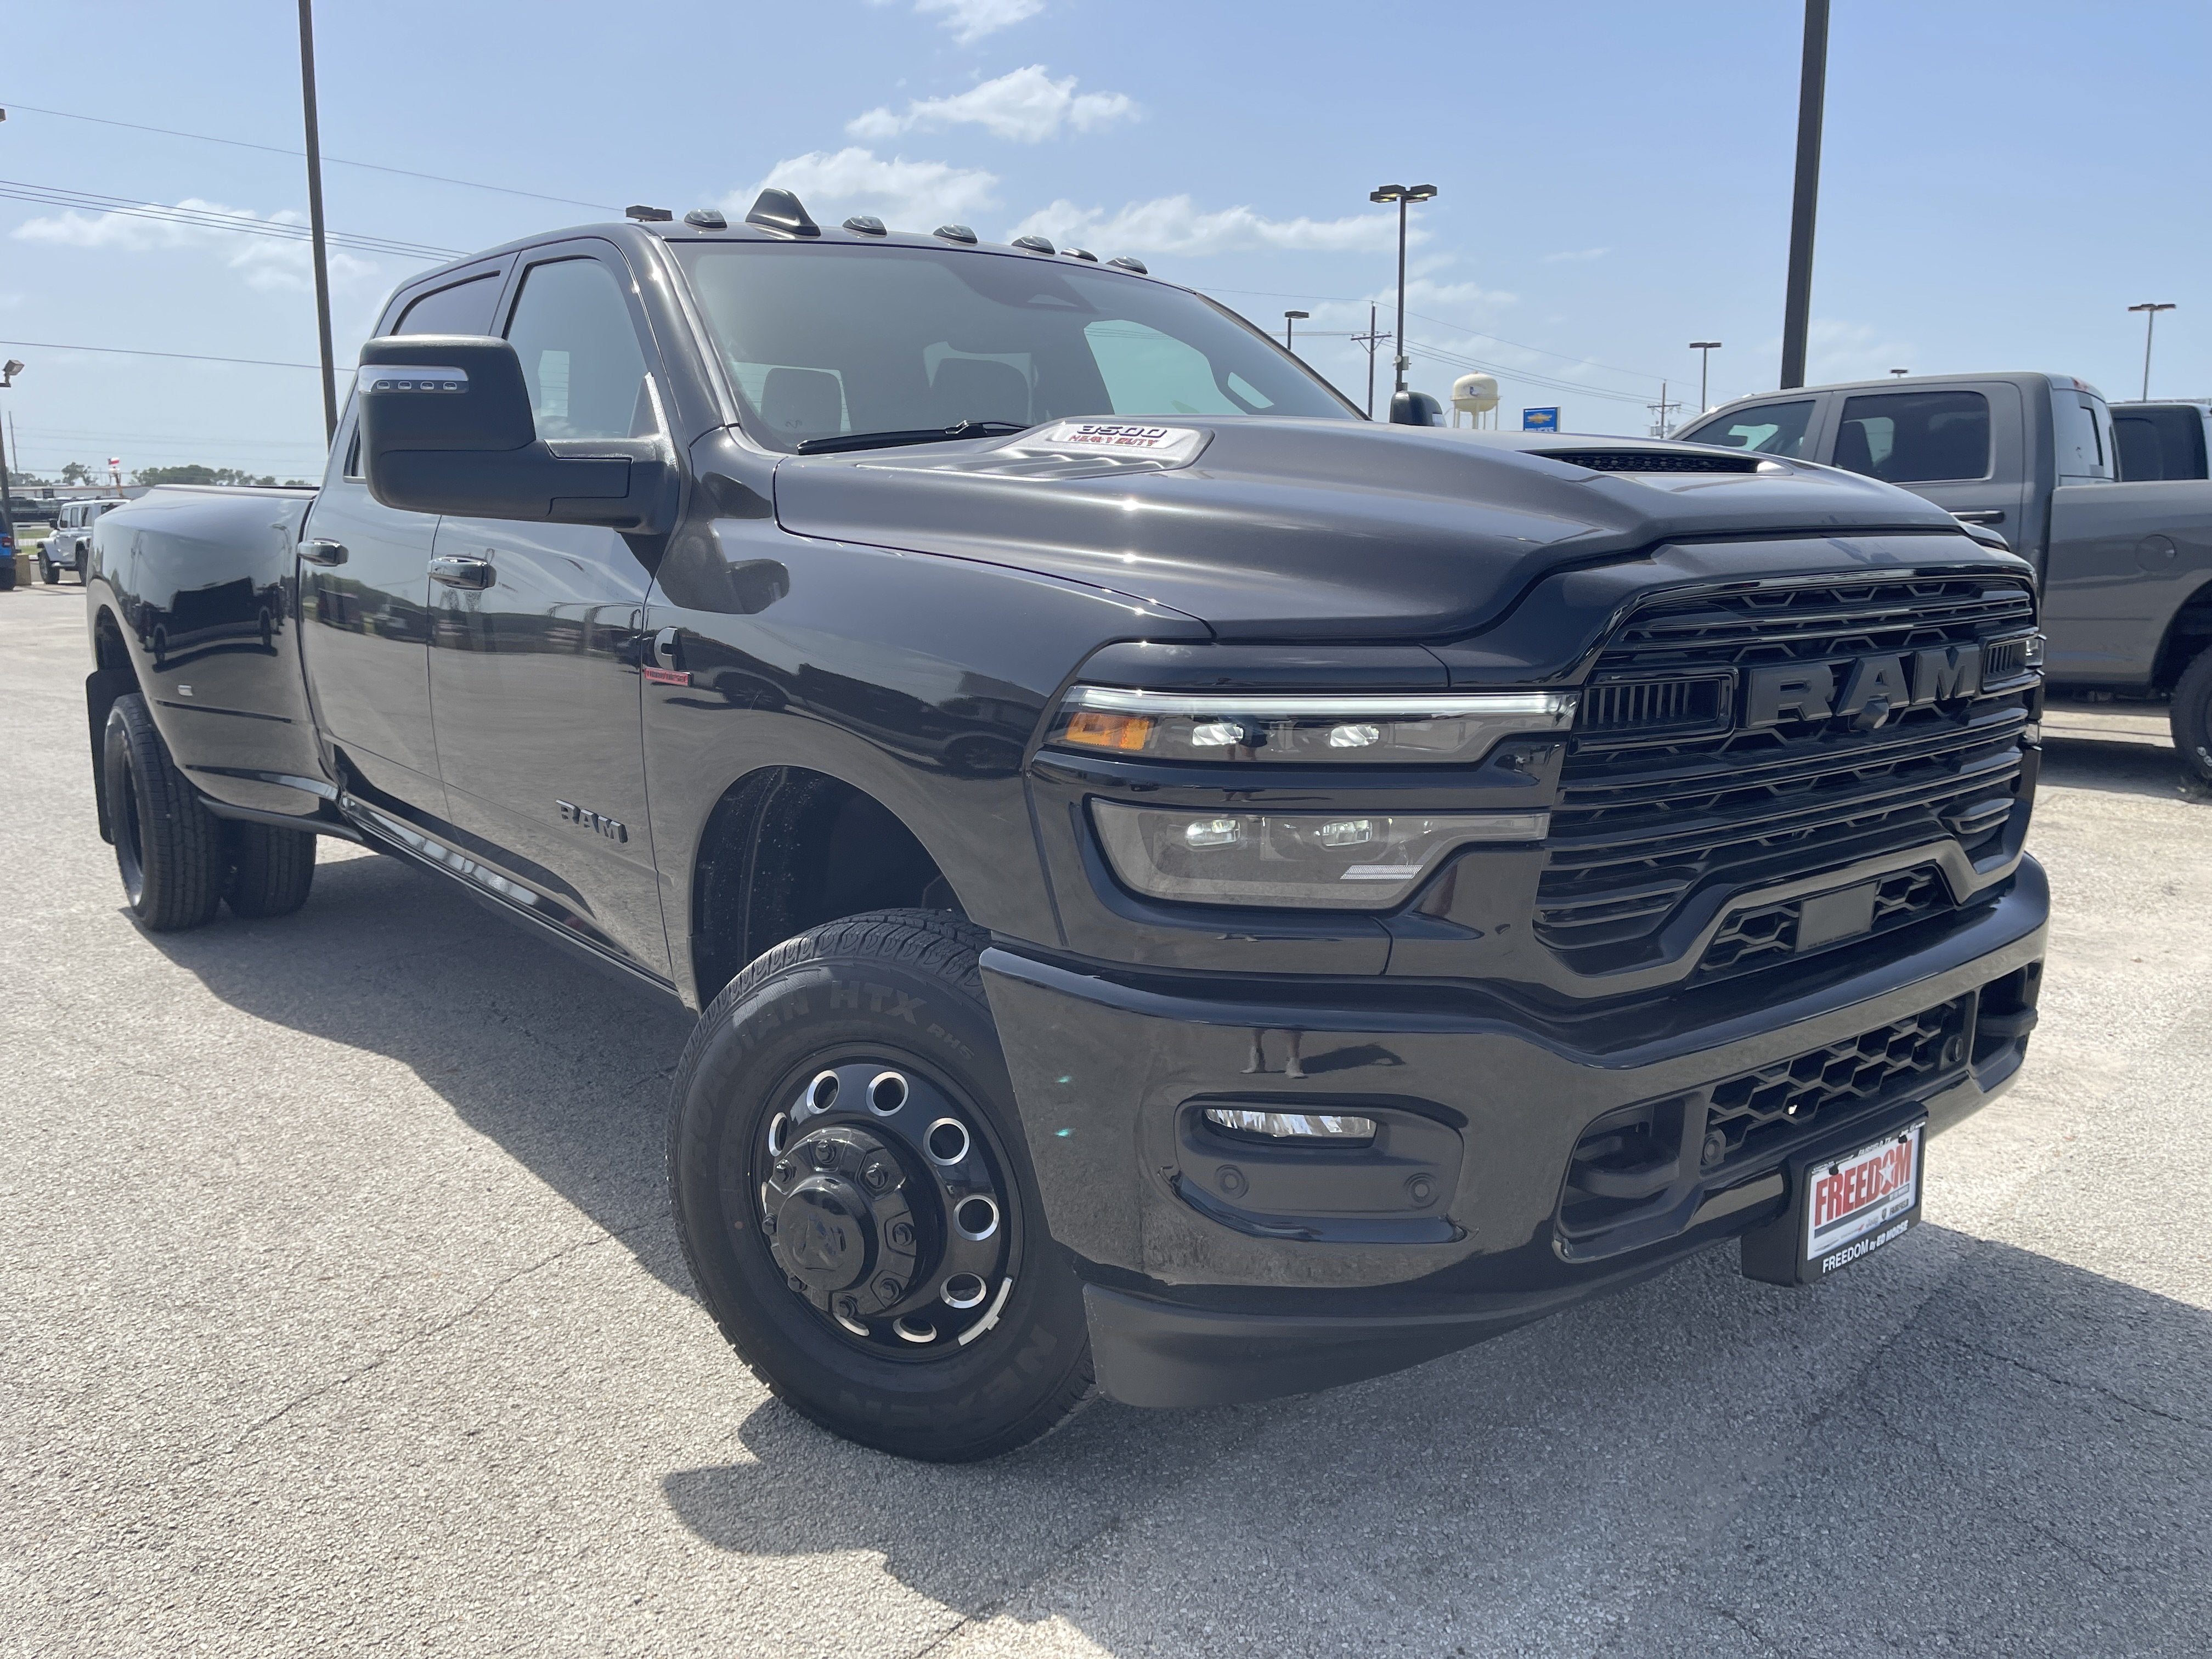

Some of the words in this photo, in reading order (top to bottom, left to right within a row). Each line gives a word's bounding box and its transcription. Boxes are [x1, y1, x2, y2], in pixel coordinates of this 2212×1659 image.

[1077, 425, 1167, 438] 3500
[1114, 437, 1159, 447] DUTY
[1747, 644, 1980, 728] RAM
[554, 799, 629, 844] RAM
[830, 980, 928, 1026] HTX
[1814, 1138, 1913, 1227] FREEDOM
[1822, 1239, 1869, 1273] FREEDOM
[1876, 1233, 1886, 1247] ED
[1886, 1220, 1909, 1242] MORSE
